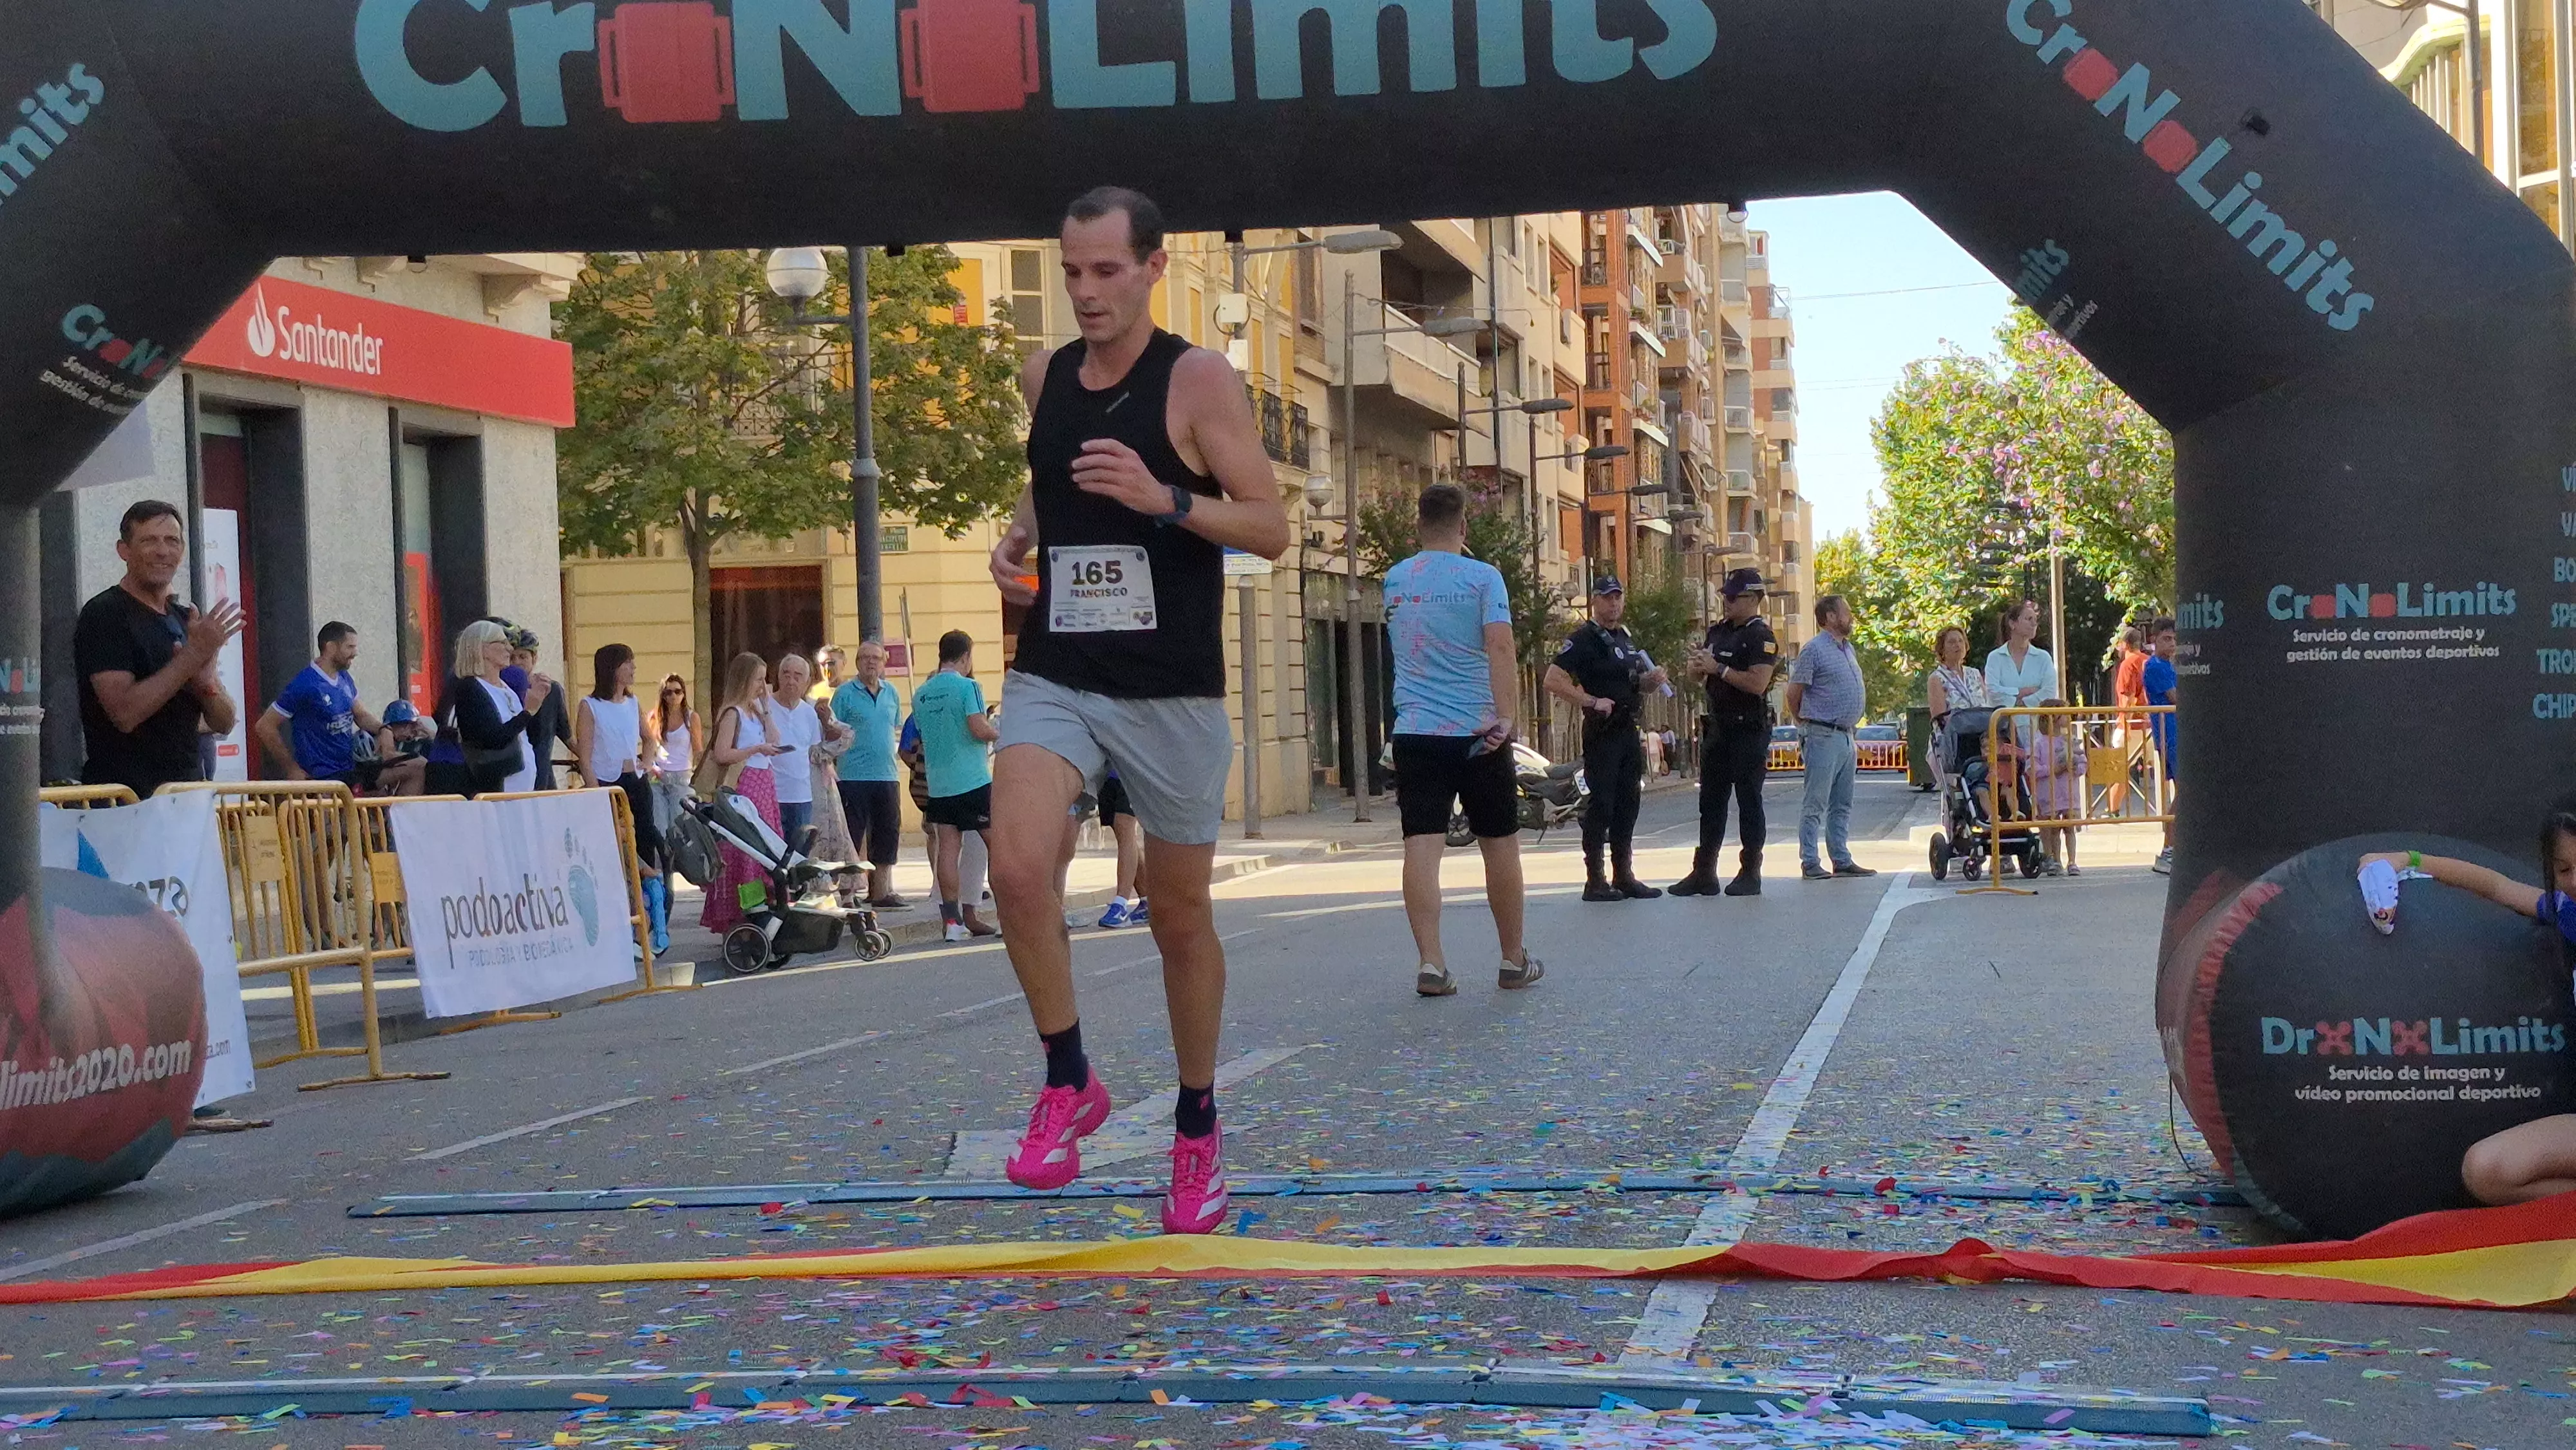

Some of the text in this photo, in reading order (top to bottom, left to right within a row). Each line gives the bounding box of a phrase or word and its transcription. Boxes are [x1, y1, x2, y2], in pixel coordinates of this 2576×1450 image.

[0, 62, 104, 206] mits
[278, 305, 383, 375] Santander
[1072, 560, 1123, 585] 165
[1070, 587, 1128, 598] FRANCISCO
[2293, 626, 2485, 643] Servicio de cronometraje y
[2286, 645, 2500, 663] gestión de eventos deportivos
[440, 872, 569, 969] podoactiva
[2329, 1064, 2505, 1082] Servicio de imagen y
[2295, 1084, 2541, 1104] vídeo promocional deportivo
